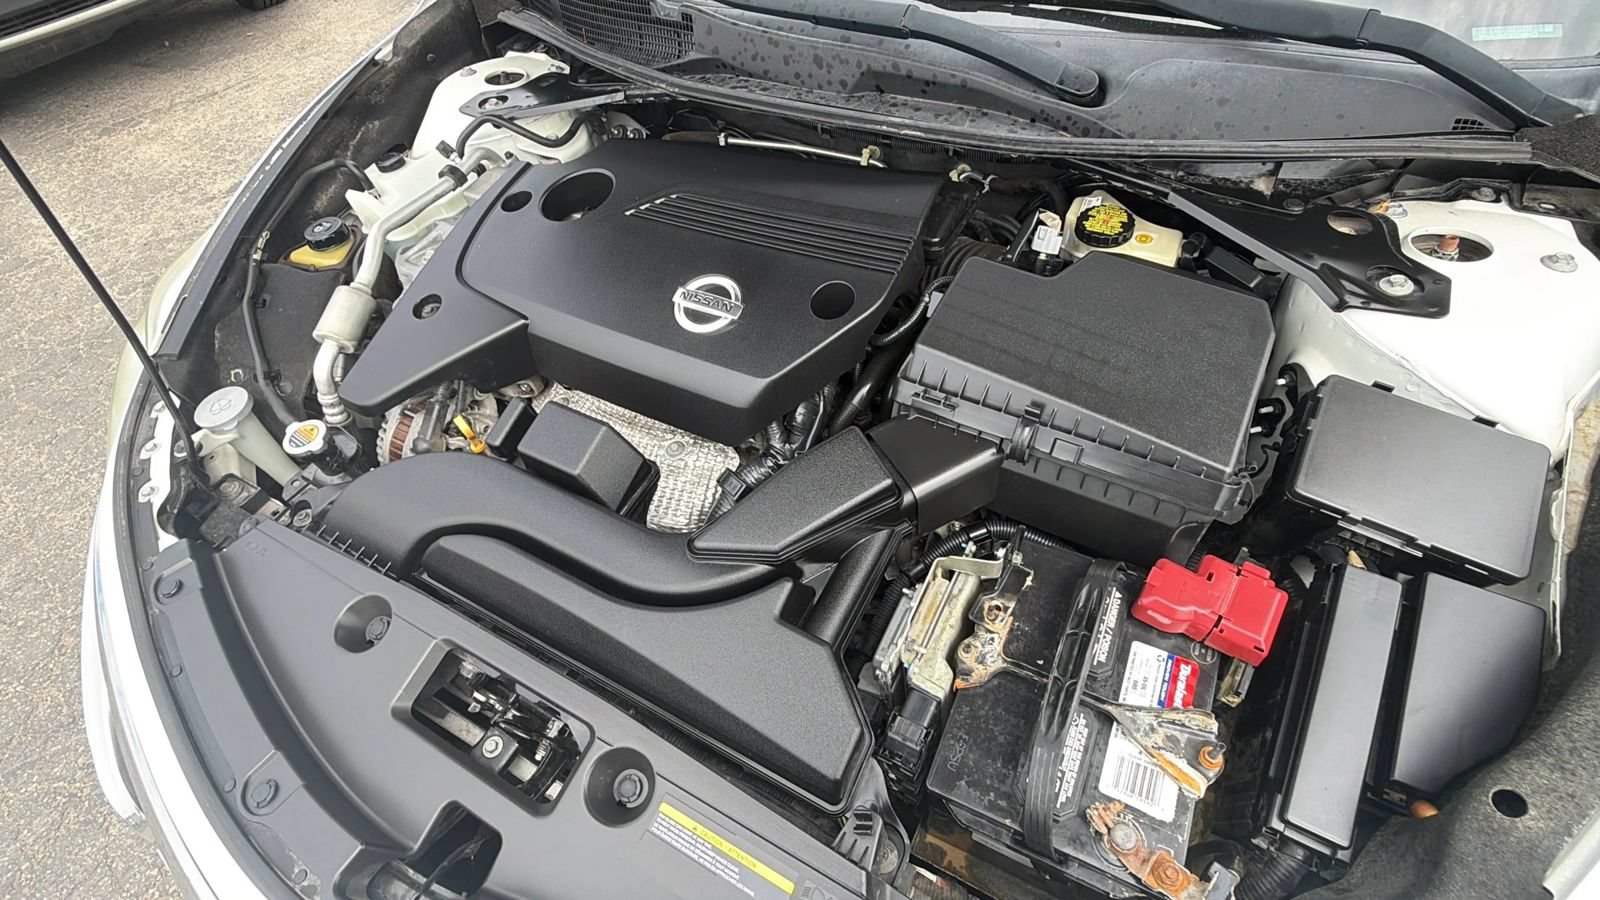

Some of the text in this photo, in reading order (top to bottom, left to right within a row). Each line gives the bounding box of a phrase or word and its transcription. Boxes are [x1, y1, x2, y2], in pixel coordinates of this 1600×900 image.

[680, 291, 734, 312] NISSAN
[1106, 598, 1121, 628] DANGER
[1097, 633, 1112, 662] POISON
[700, 829, 756, 869] CAUTION ATTENTION
